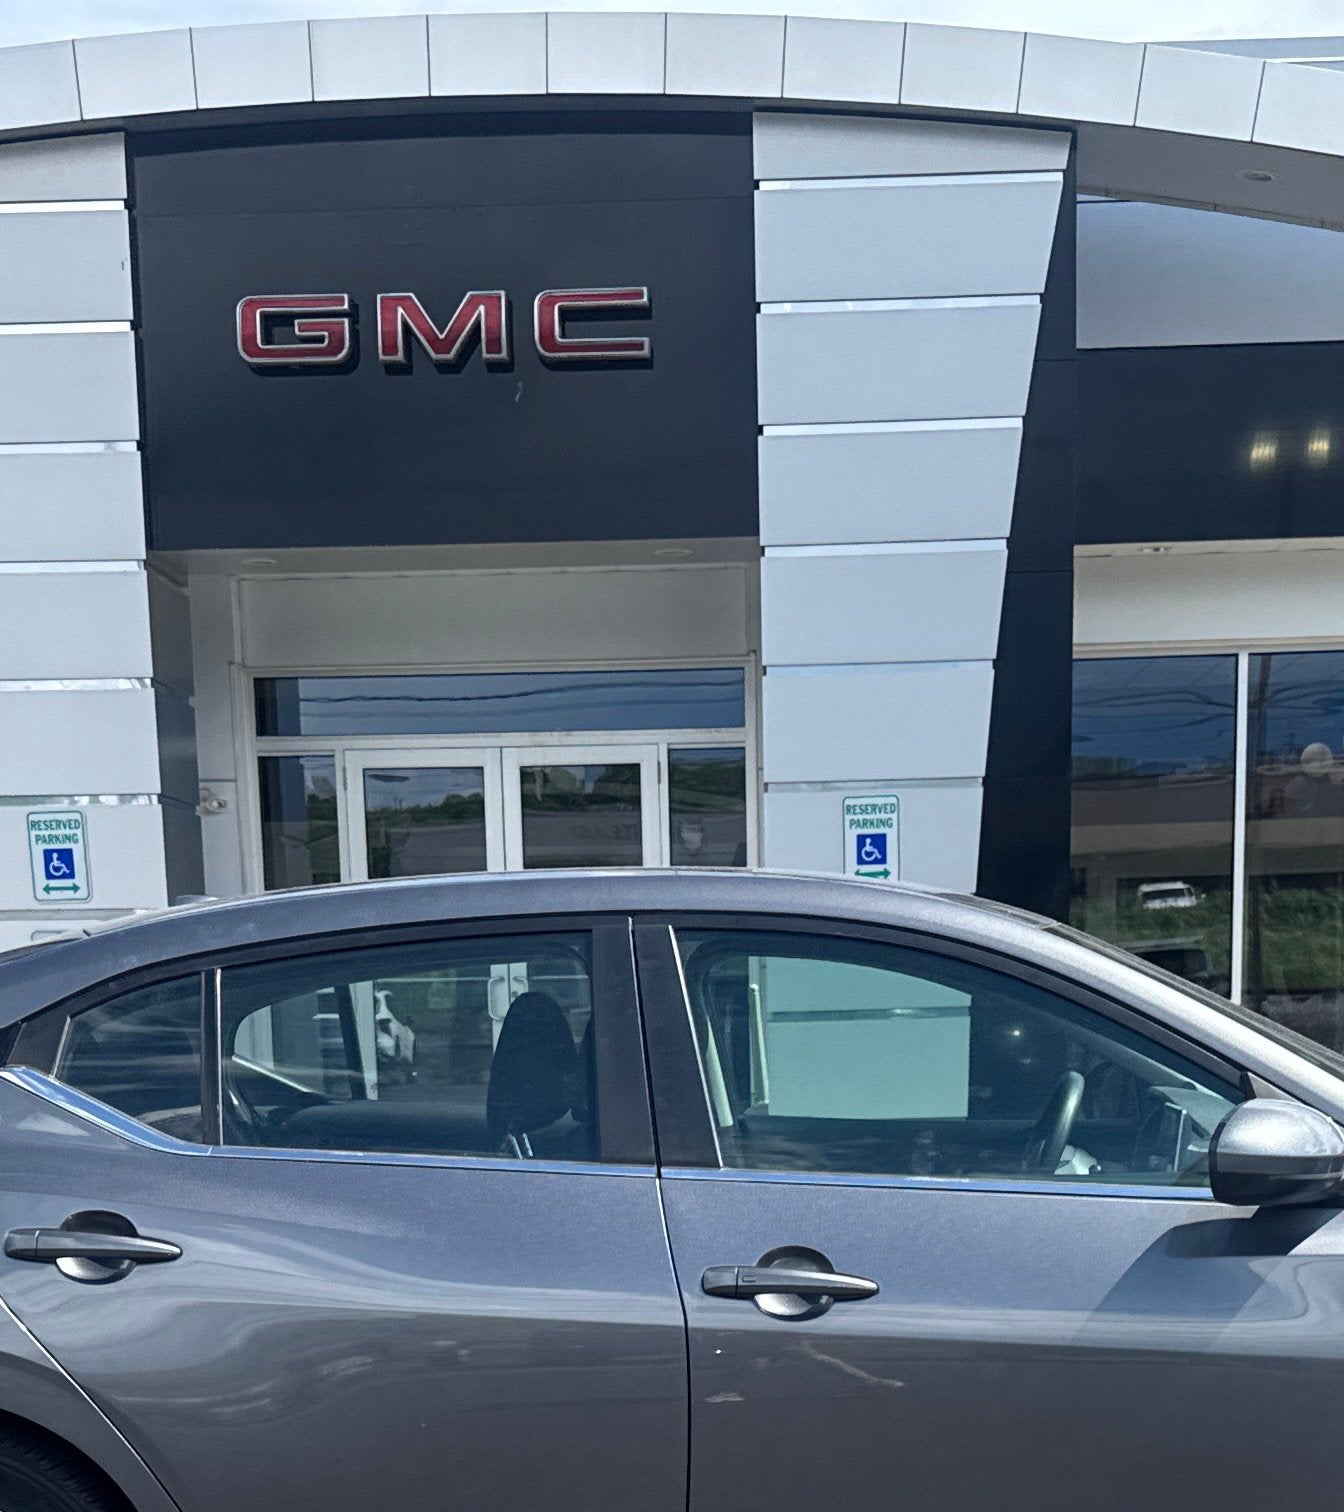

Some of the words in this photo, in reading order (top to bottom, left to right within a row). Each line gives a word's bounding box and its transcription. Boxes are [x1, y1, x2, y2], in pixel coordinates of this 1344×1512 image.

[236, 287, 652, 365] GMC
[845, 803, 896, 816] RESERVED
[30, 819, 81, 831] RESERVED
[849, 817, 893, 830] PARKING
[35, 833, 79, 845] PARKING
